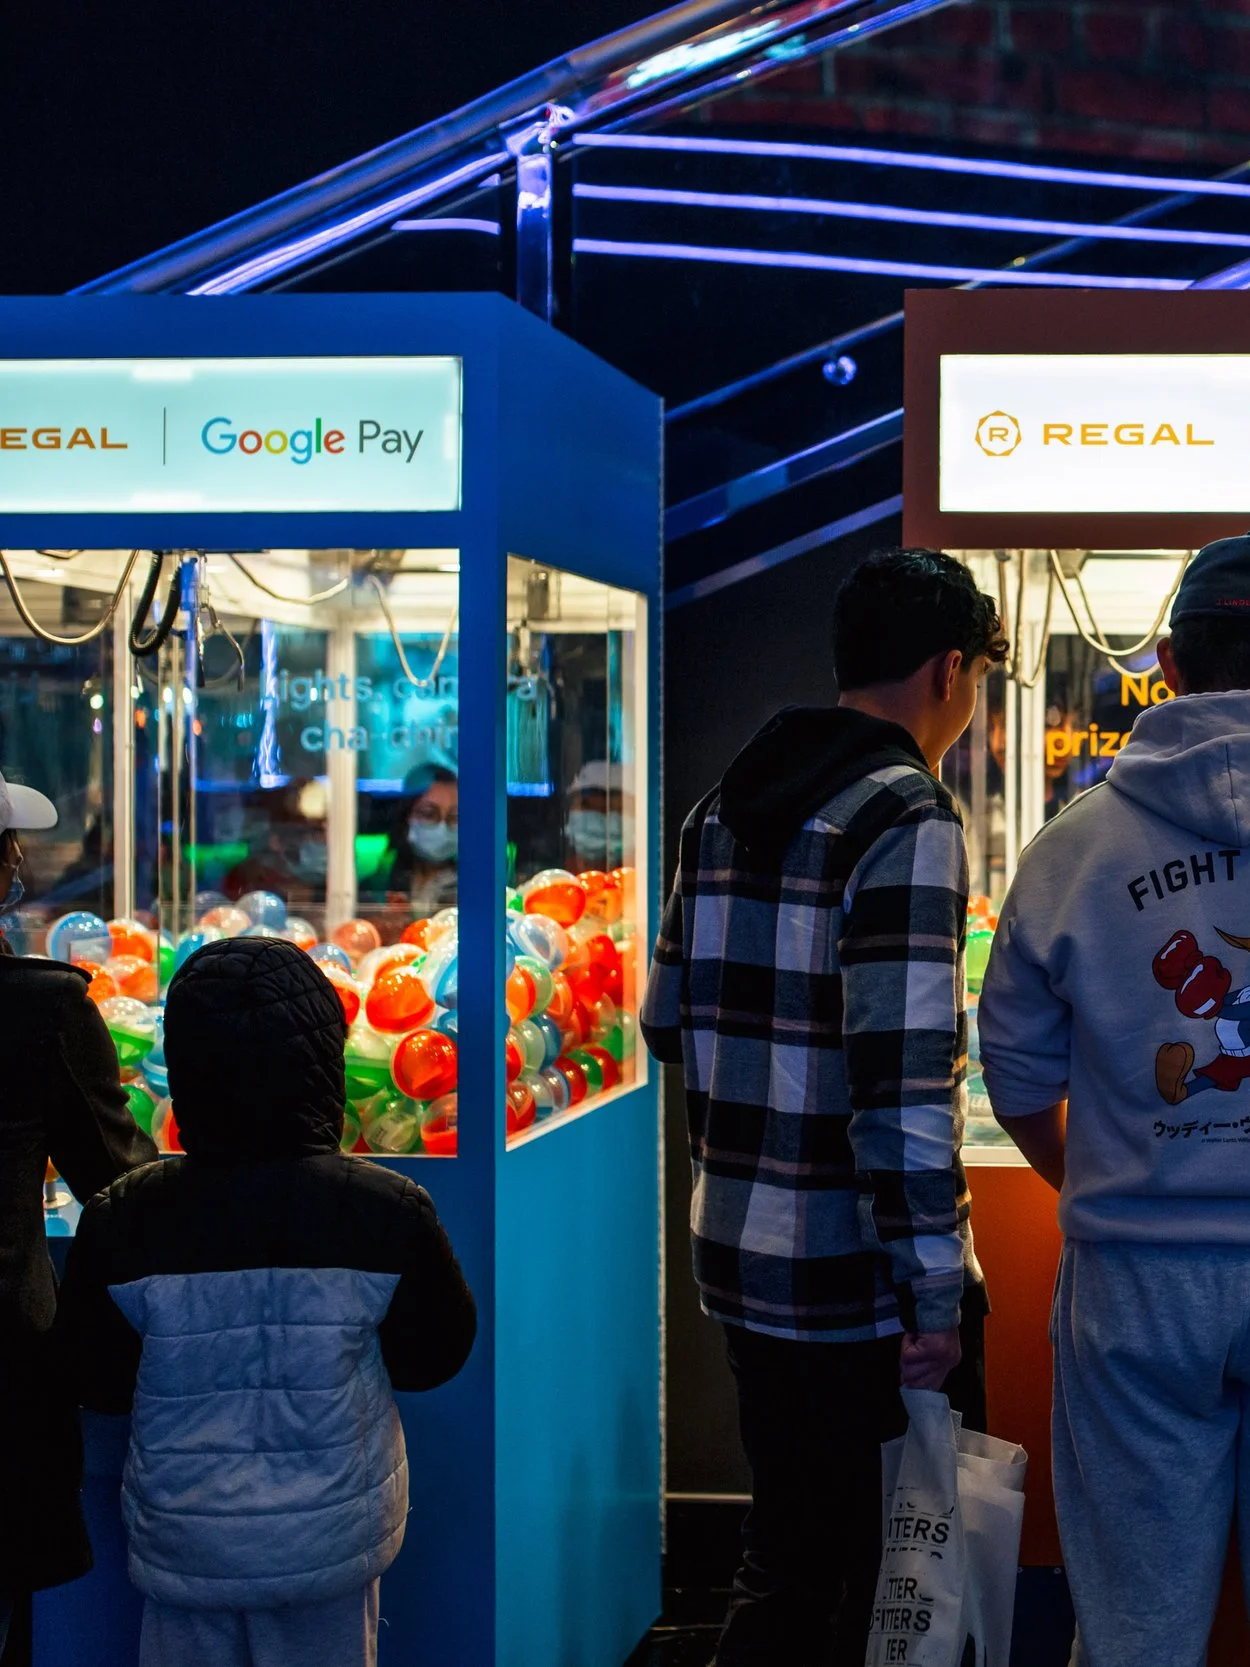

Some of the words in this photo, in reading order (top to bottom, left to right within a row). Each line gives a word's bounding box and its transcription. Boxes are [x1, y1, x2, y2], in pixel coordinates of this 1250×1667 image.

[0, 426, 128, 450] EGAL
[201, 416, 345, 465] Google
[359, 420, 424, 463] Pay
[1042, 423, 1215, 446] REGAL
[1121, 674, 1176, 707] No
[1045, 722, 1132, 767] priz
[1127, 850, 1241, 912] FIGHT
